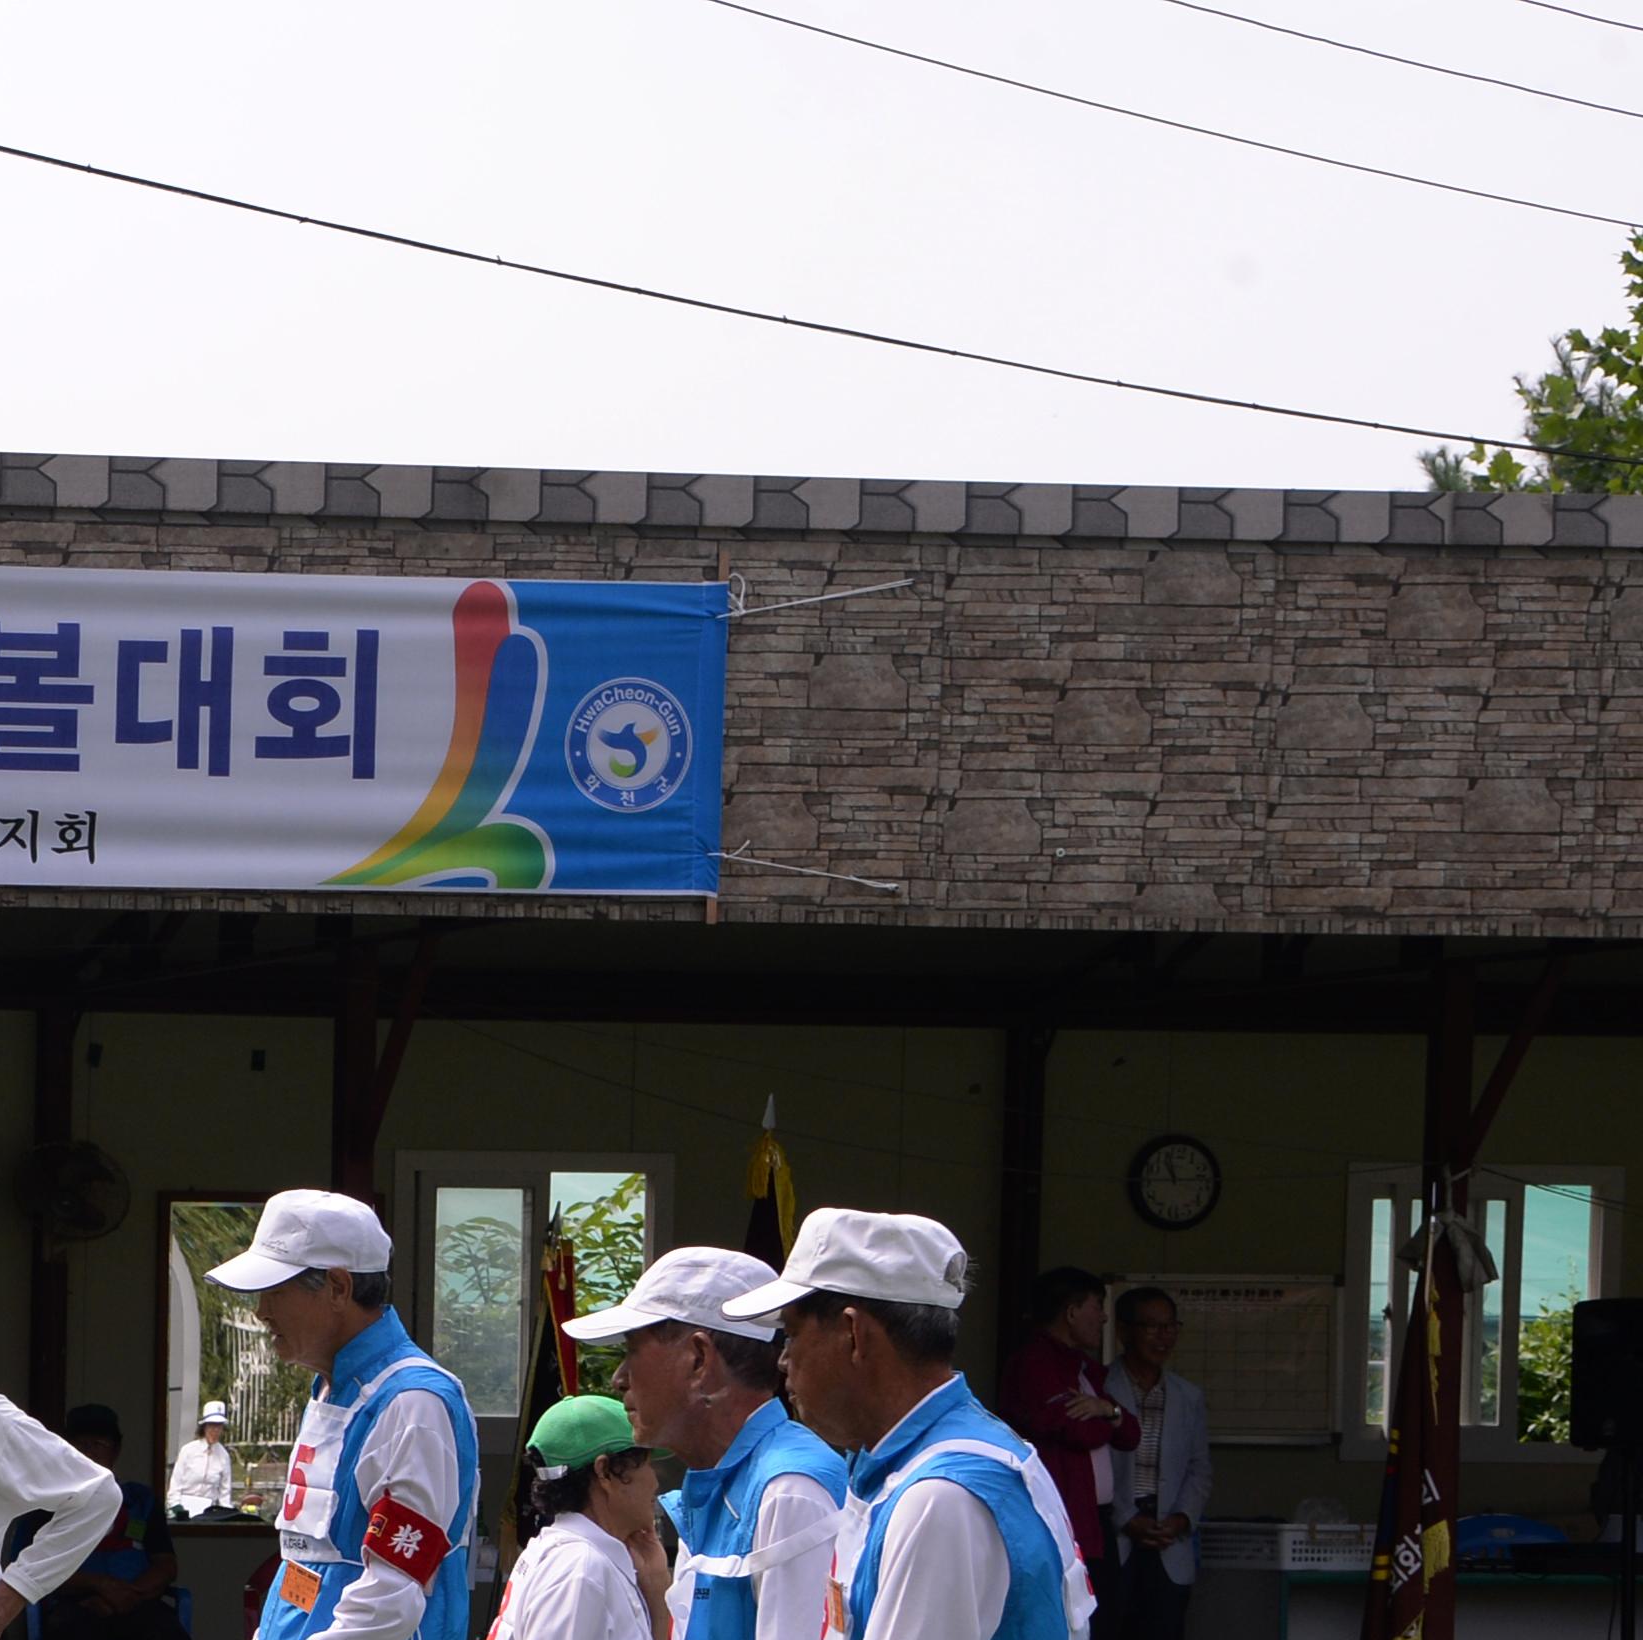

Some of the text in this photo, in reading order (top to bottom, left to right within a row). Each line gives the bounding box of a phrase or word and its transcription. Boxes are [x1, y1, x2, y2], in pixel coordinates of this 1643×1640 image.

[575, 687, 681, 737] HwaCheon-Gun
[283, 1444, 316, 1521] 5
[388, 1523, 424, 1559] 將
